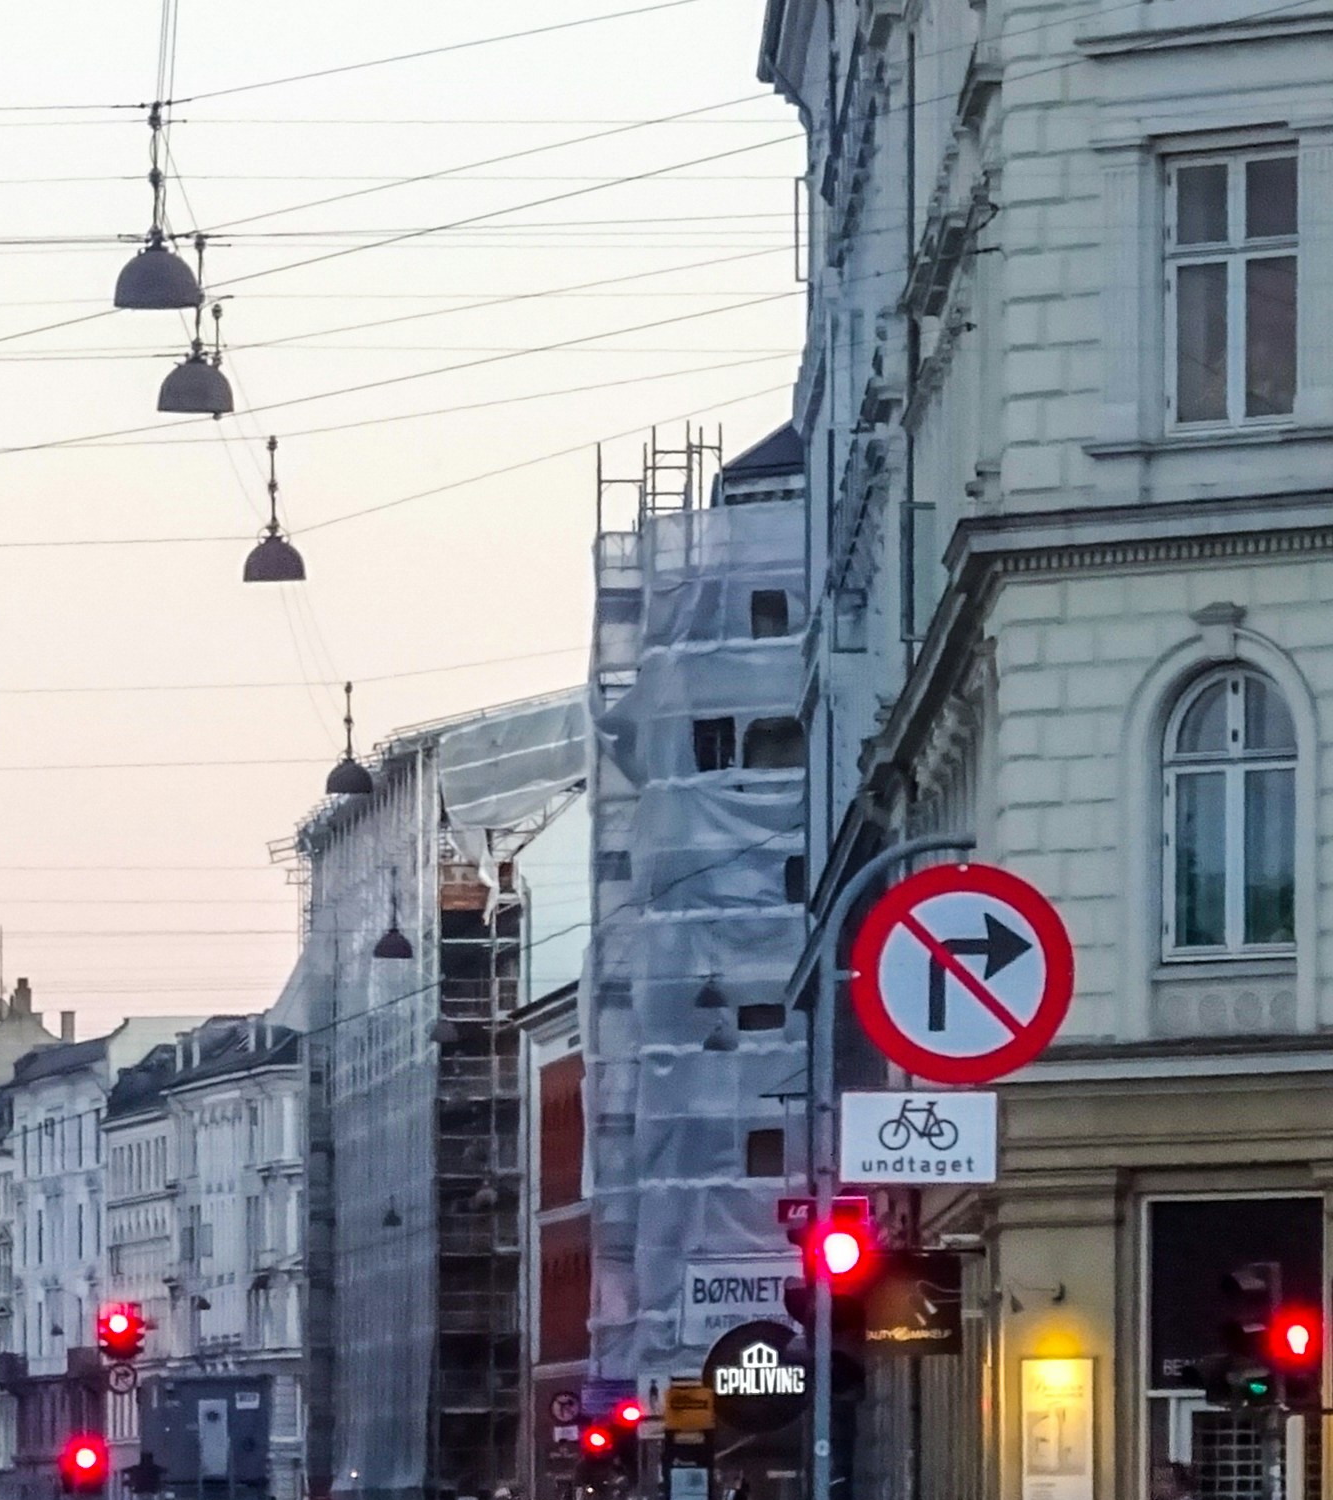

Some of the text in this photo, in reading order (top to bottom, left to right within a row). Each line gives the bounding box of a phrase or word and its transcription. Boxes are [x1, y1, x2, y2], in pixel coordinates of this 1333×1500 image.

[861, 1156, 974, 1176] undtaget
[692, 1276, 785, 1304] BØRNET
[716, 1367, 806, 1395] CPHLIVING
